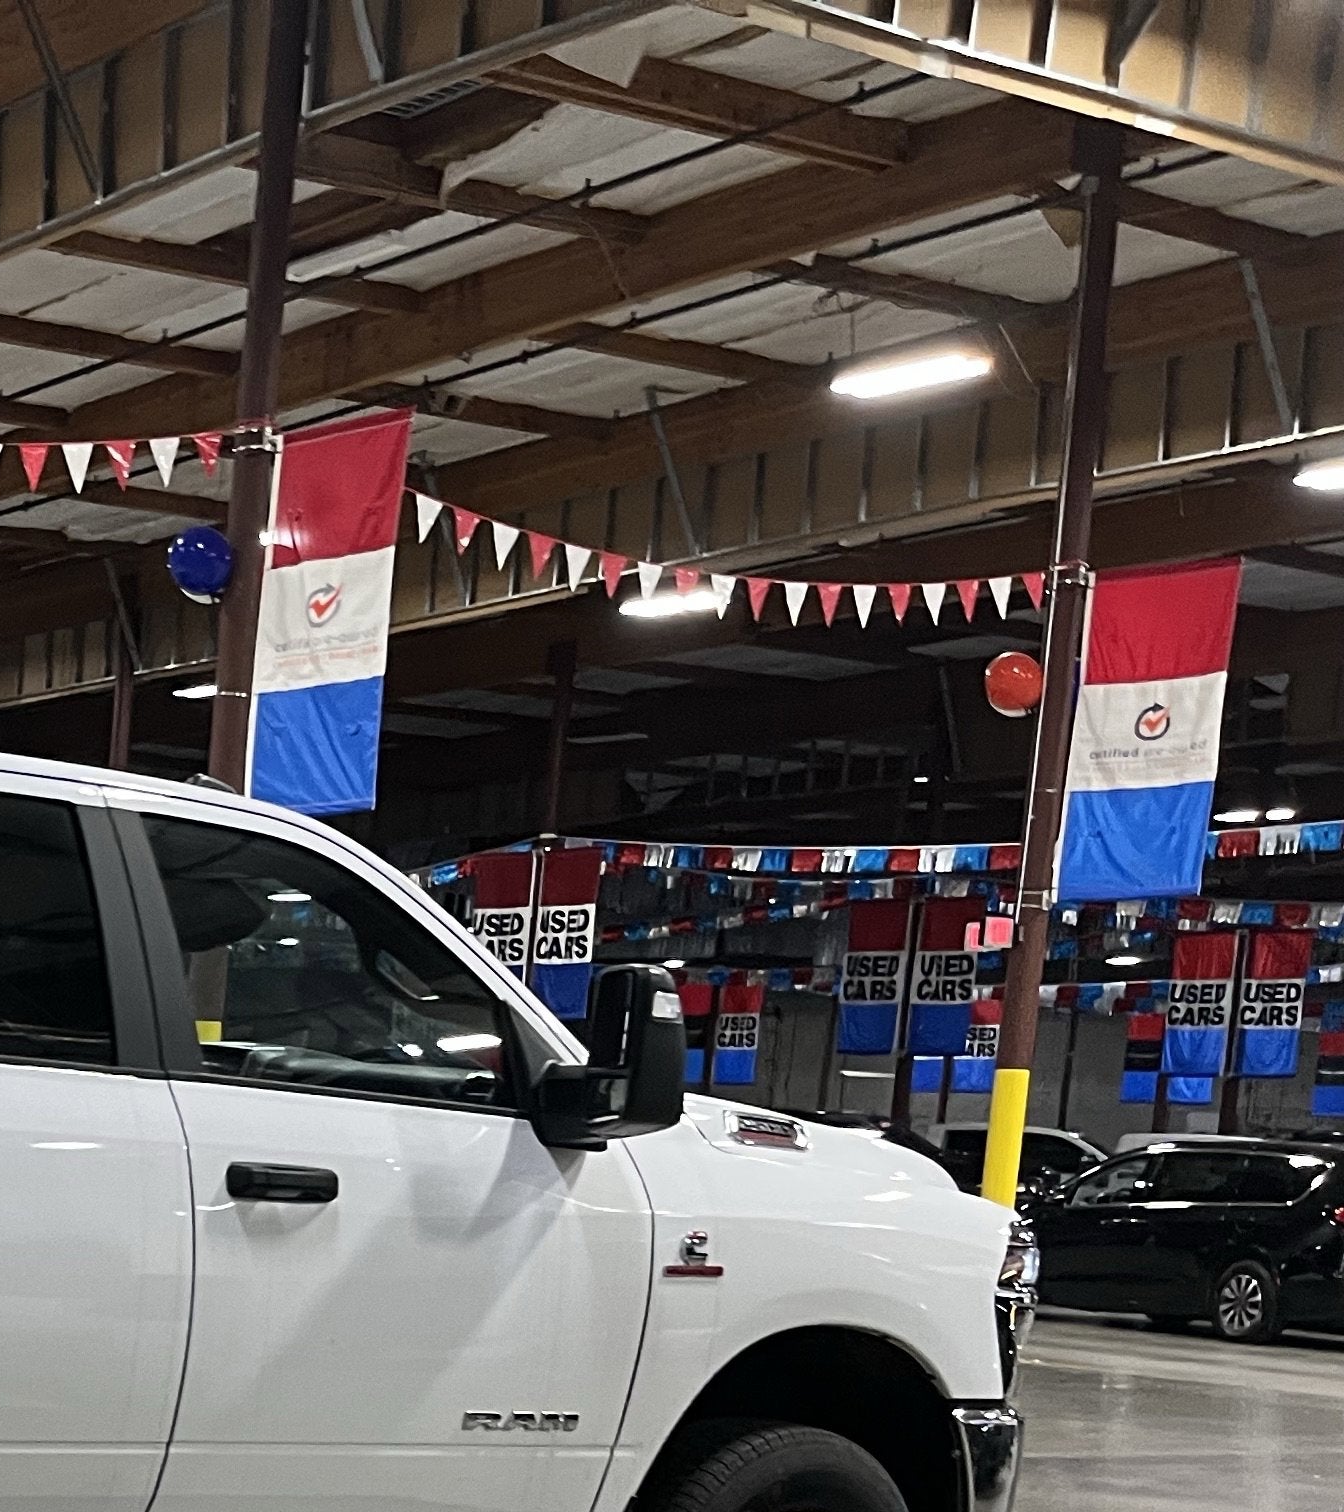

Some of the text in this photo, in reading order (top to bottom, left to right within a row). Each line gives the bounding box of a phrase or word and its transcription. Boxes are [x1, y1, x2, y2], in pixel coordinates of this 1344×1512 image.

[540, 909, 590, 933] USED
[485, 938, 524, 961] ARS
[535, 935, 588, 959] CARS
[846, 955, 900, 977] USED
[843, 979, 897, 1001] CARS
[916, 979, 972, 1001] CARS
[1170, 983, 1227, 1004] USED
[1243, 982, 1302, 1004] USED
[1167, 1005, 1225, 1026] CARS
[1240, 1005, 1299, 1026] CARS
[966, 1027, 997, 1041] SED
[966, 1043, 996, 1057] ARS
[461, 1410, 579, 1432] RAM
